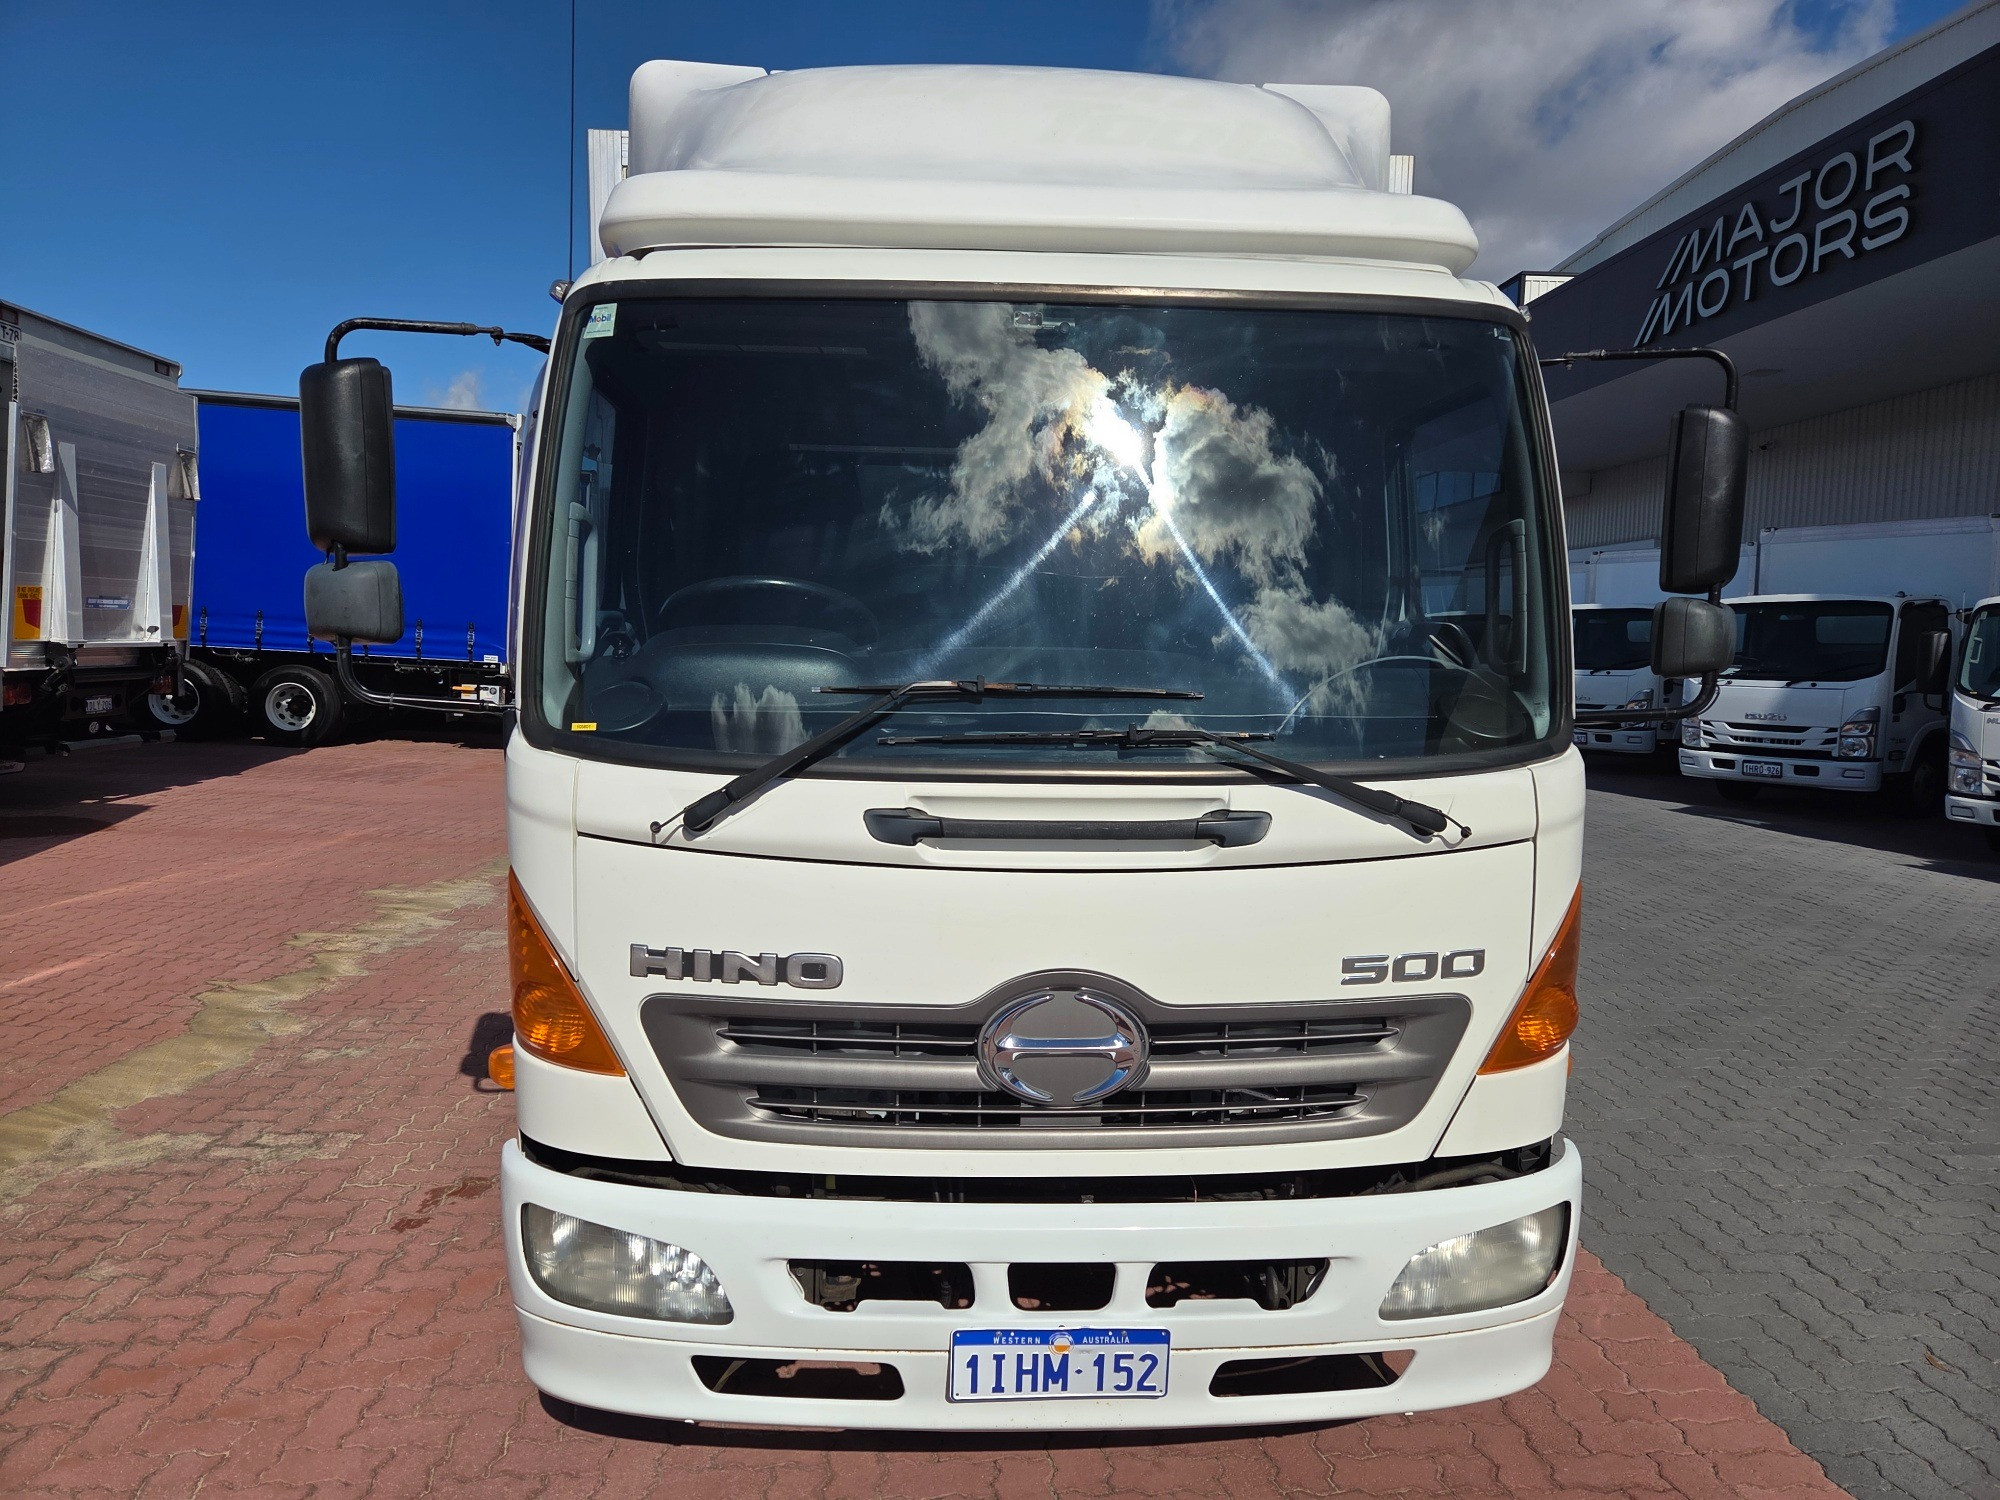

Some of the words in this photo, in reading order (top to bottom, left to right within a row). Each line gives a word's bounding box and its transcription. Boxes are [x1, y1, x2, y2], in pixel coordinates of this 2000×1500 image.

[1656, 120, 1915, 290] MAJOR
[1633, 184, 1911, 348] MOTORS
[589, 313, 612, 324] Mobil
[1745, 712, 1787, 721] ISUZU
[630, 943, 843, 989] HINO
[1341, 949, 1485, 985] 500
[993, 1336, 1041, 1345] WESTERN
[1083, 1336, 1130, 1344] AUSTRALIA
